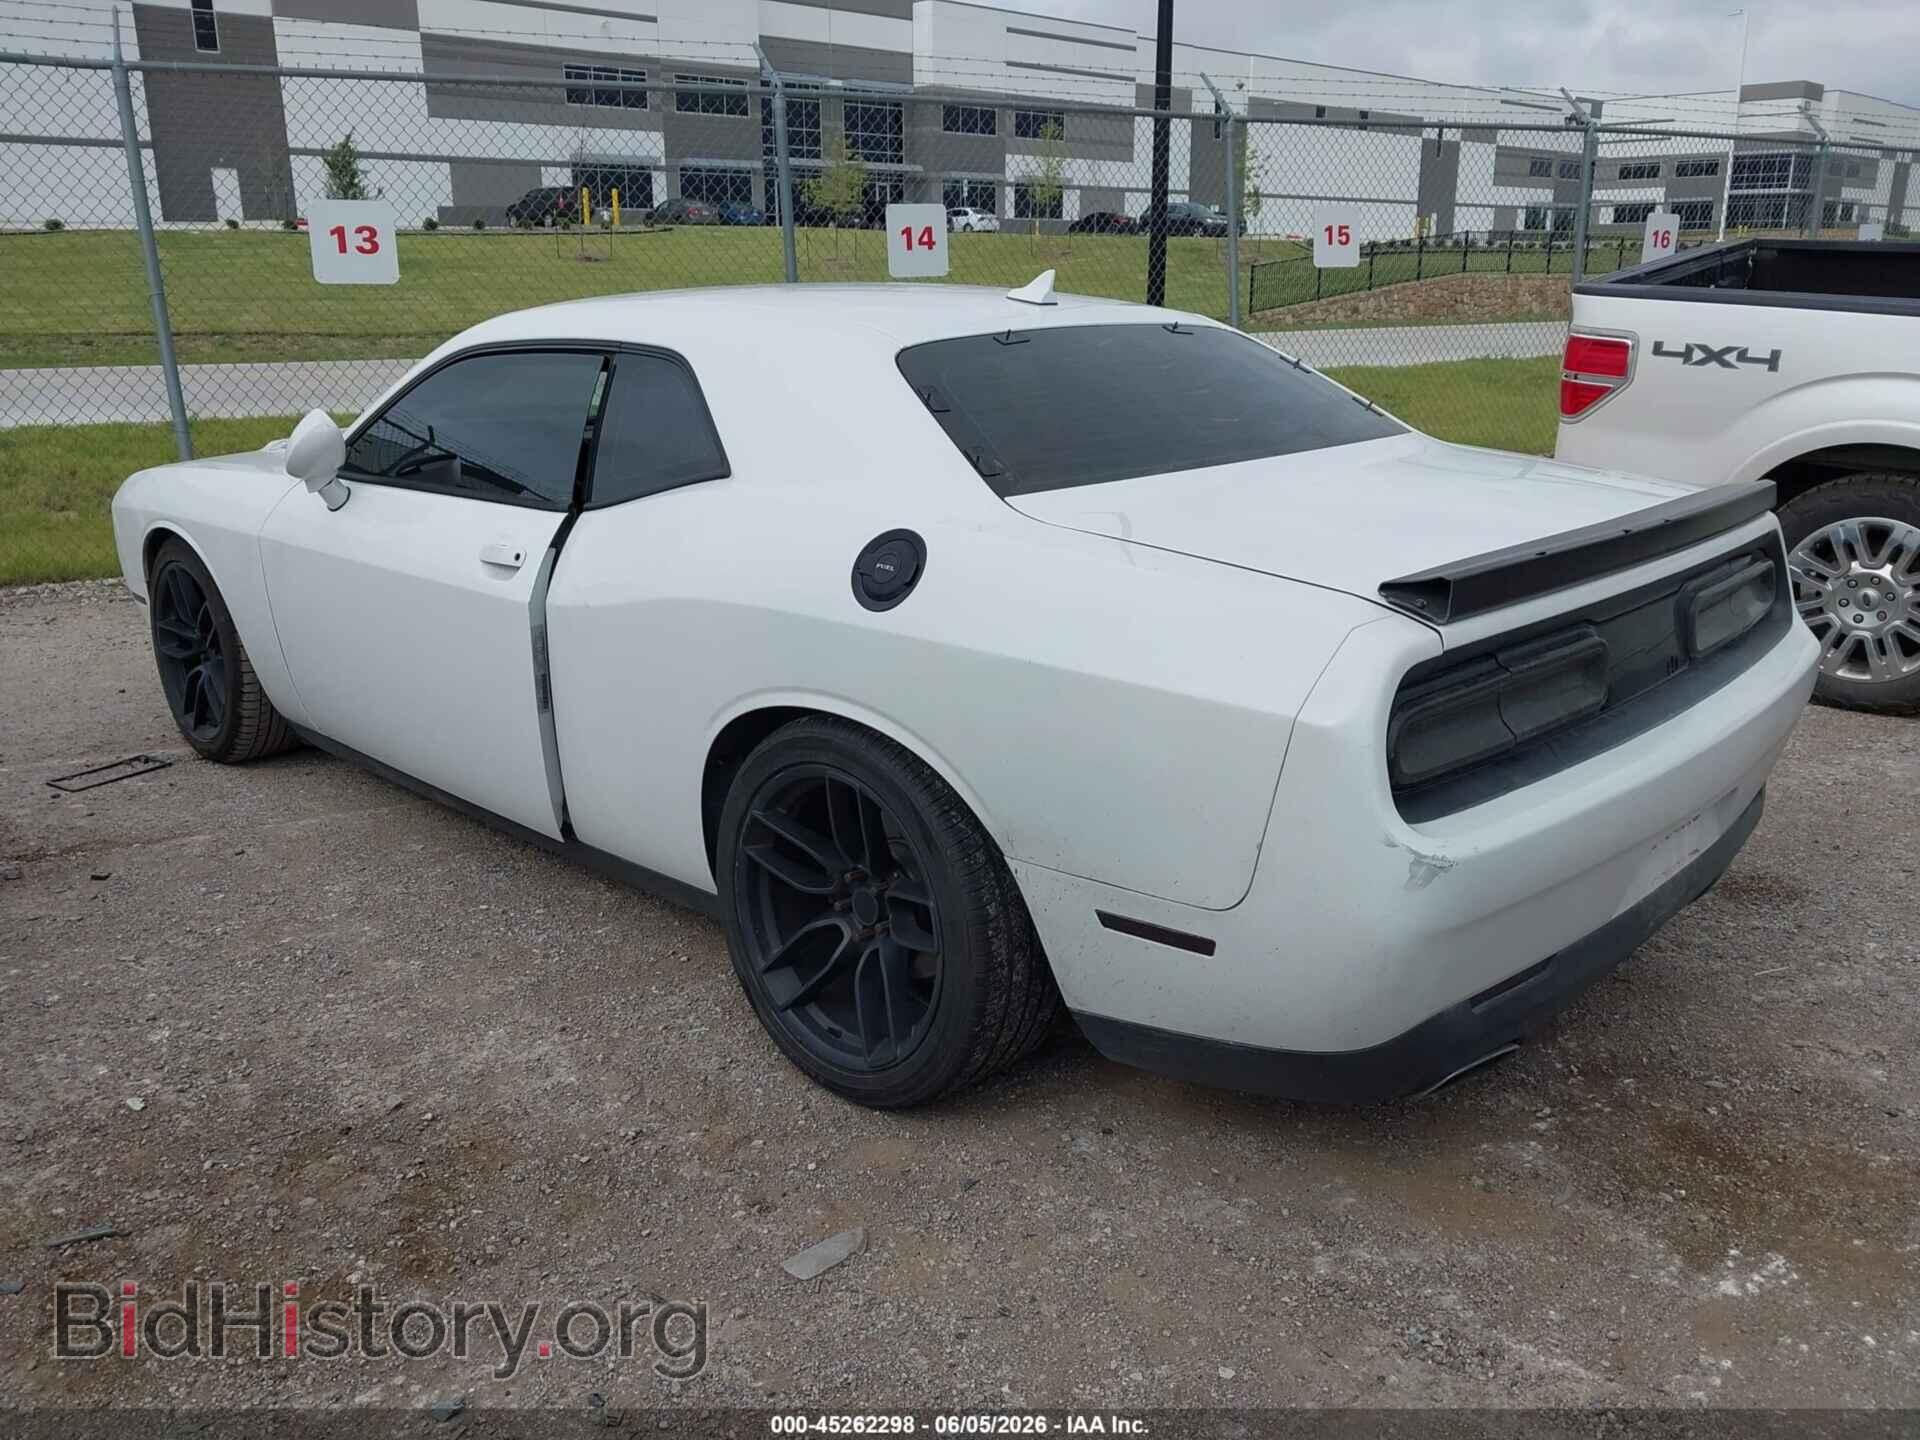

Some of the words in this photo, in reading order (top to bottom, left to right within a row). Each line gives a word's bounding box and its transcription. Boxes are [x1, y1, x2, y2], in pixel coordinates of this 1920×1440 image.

[329, 225, 380, 255] 13
[901, 226, 936, 251] 14
[1324, 225, 1350, 246] 15
[1652, 230, 1671, 249] 16
